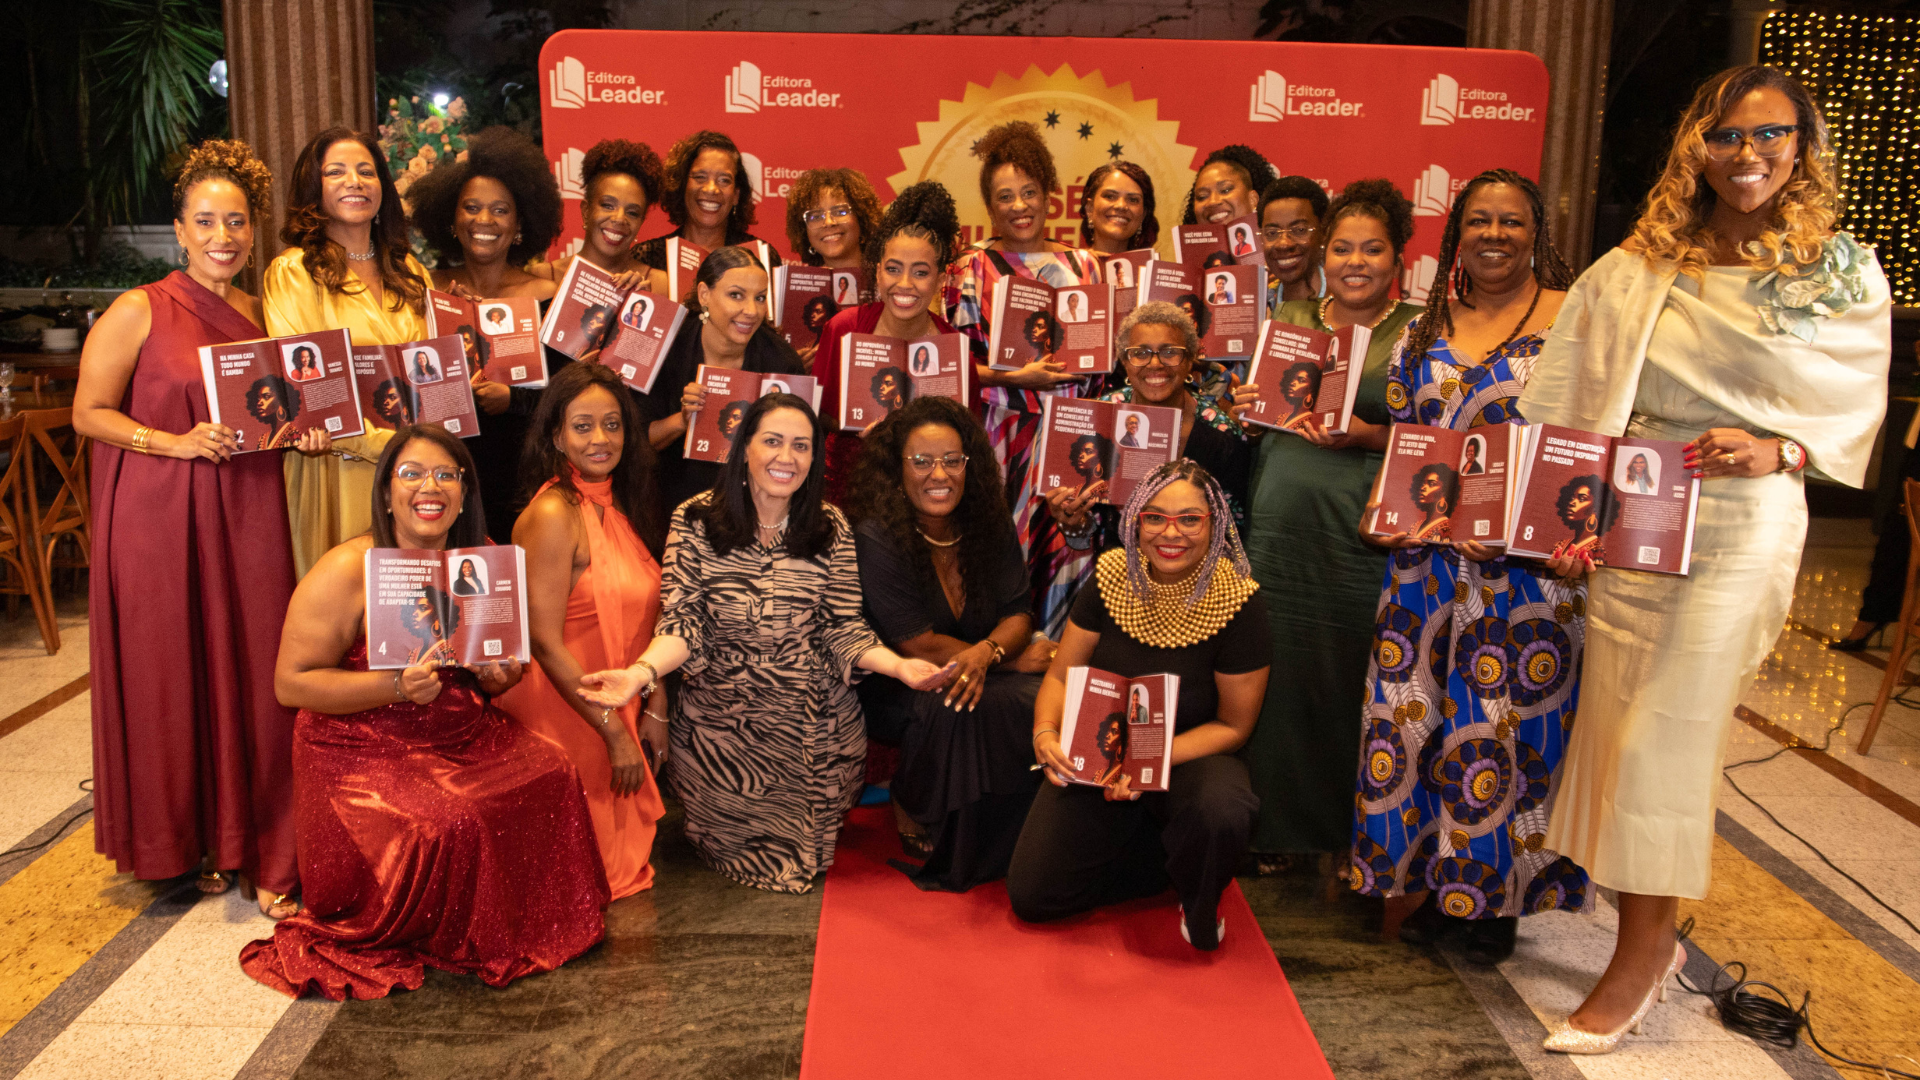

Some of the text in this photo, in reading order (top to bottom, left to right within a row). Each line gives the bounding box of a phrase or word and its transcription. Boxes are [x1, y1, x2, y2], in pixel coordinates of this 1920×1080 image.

[587, 72, 635, 84] Editora
[763, 76, 811, 87] Editora
[1288, 85, 1335, 97] Editora
[1461, 88, 1507, 100] Editora
[557, 331, 565, 342] 9
[1282, 331, 1301, 341] RONDÔNIA
[1004, 348, 1015, 359] 17
[1271, 344, 1289, 354] JORNADA
[1296, 349, 1320, 361] RESILIÊNCIA
[1273, 351, 1295, 362] LIDERANÇA
[713, 387, 730, 396] RELAÇÕES
[1061, 405, 1087, 415] IMPORTÂNCIA
[1255, 400, 1266, 413] 11
[852, 408, 863, 420] 13
[1055, 419, 1087, 428] ADMINISTRAÇÃO
[1055, 426, 1075, 434] PEQUENAS
[237, 430, 244, 443] 2
[1401, 433, 1419, 441] LEVANDO
[1547, 437, 1566, 447] LEGADO
[1567, 440, 1575, 448] EM
[696, 440, 709, 452] 23
[1551, 456, 1574, 466] PASSADO
[1554, 448, 1574, 457] FUTURO
[1574, 450, 1600, 462] INSPIRADO
[1049, 475, 1060, 487] 16
[1386, 512, 1398, 525] 14
[1523, 525, 1534, 540] 8
[378, 641, 386, 655] 4
[1073, 756, 1084, 771] 18
